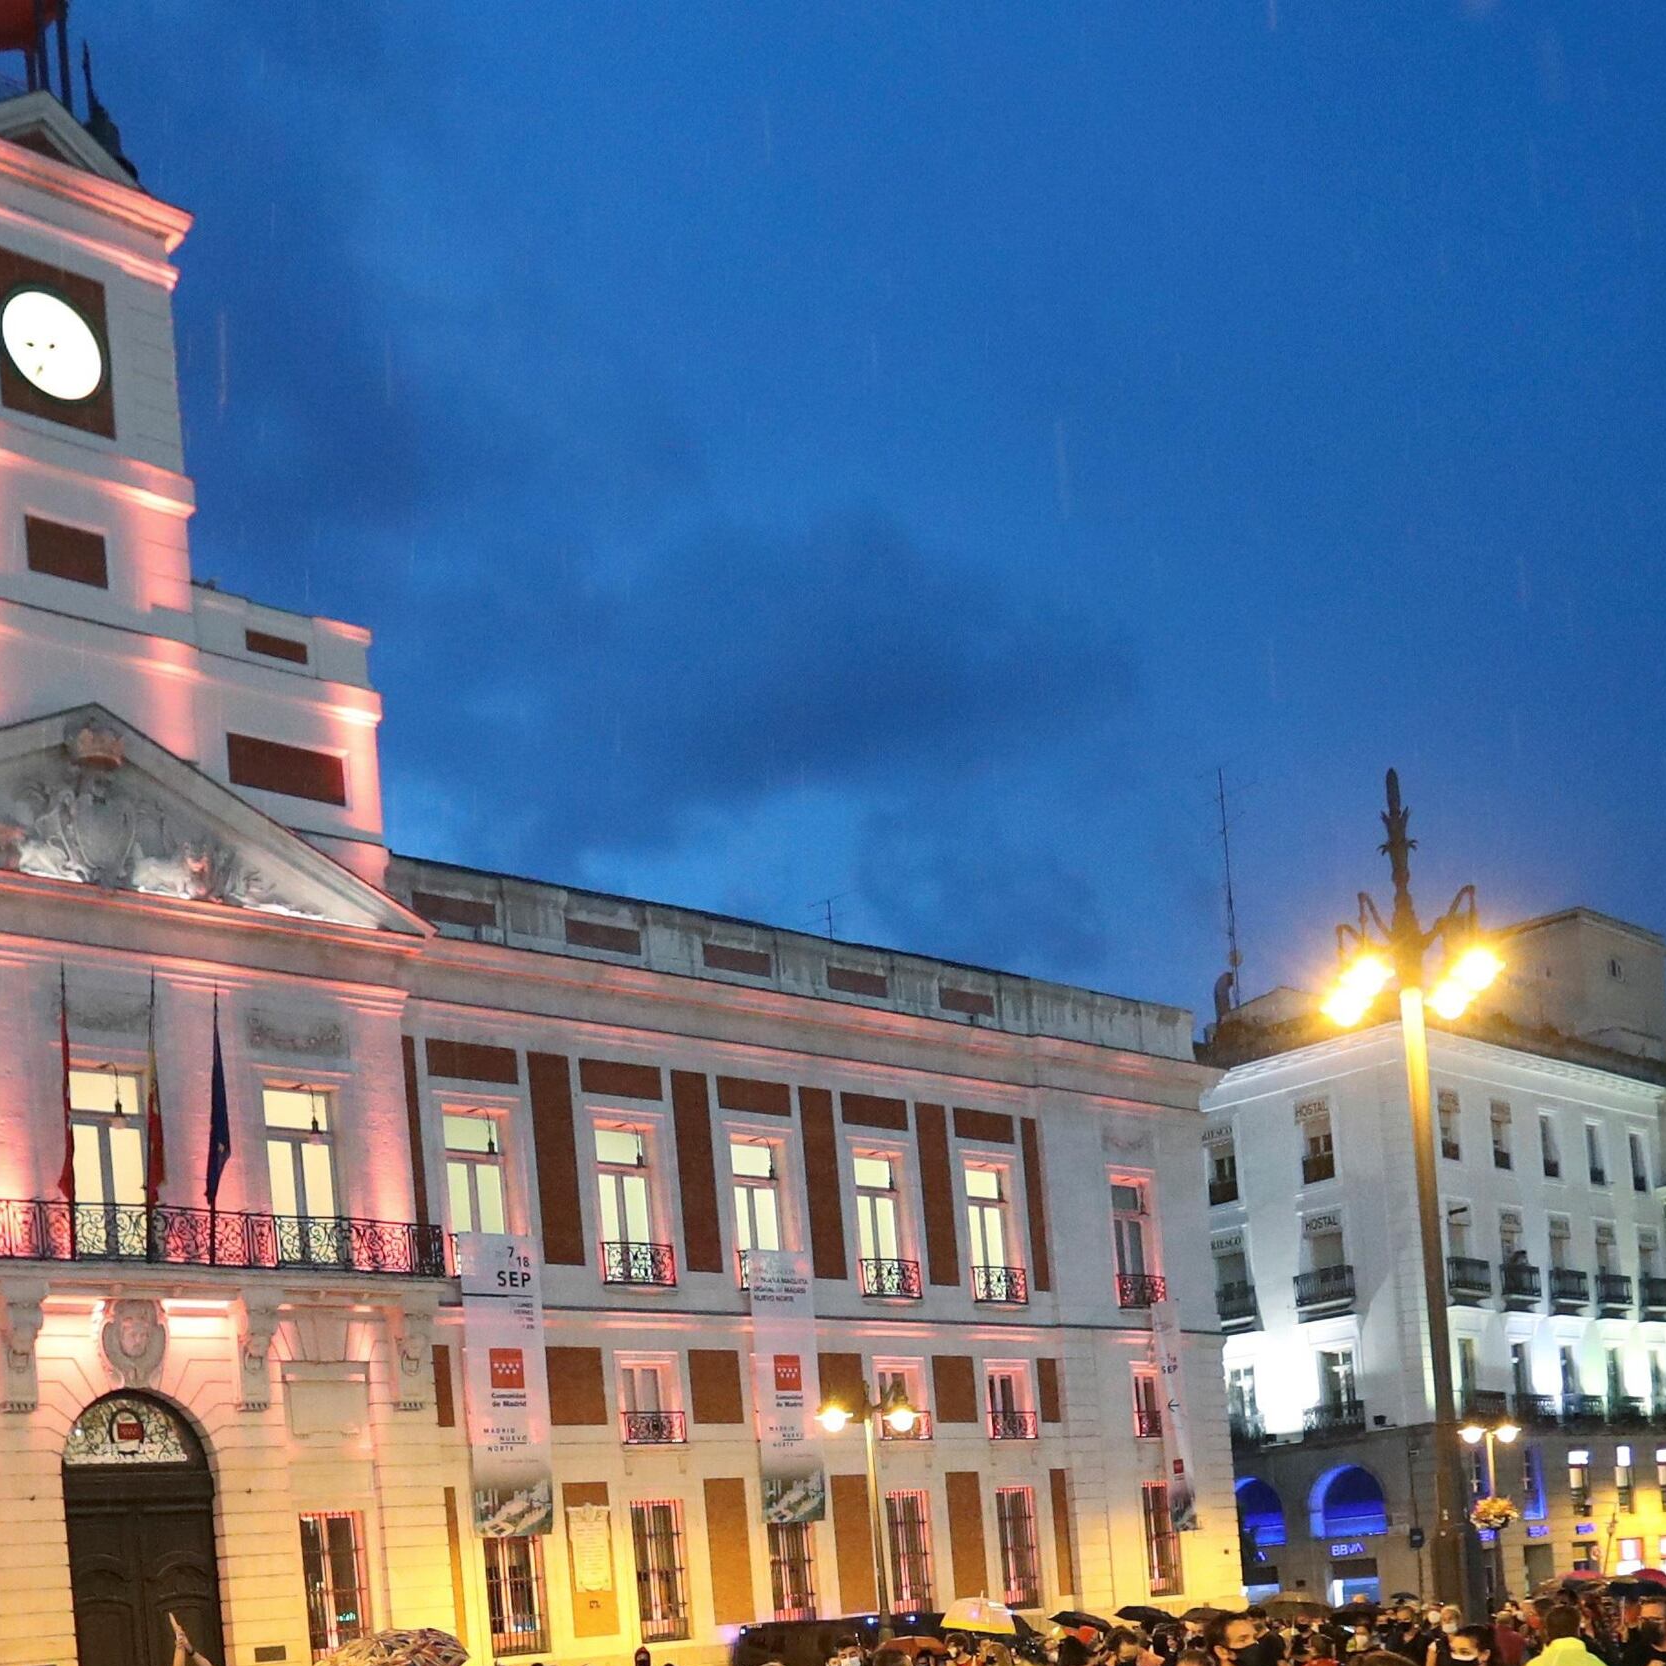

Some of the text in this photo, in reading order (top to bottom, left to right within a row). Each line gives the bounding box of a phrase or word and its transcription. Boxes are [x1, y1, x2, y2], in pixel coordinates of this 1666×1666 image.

[506, 1245, 515, 1258] 7
[517, 1256, 530, 1267] 18
[496, 1269, 532, 1288] SEP
[502, 1400, 527, 1408] Madrid
[1331, 1542, 1364, 1557] BBVA
